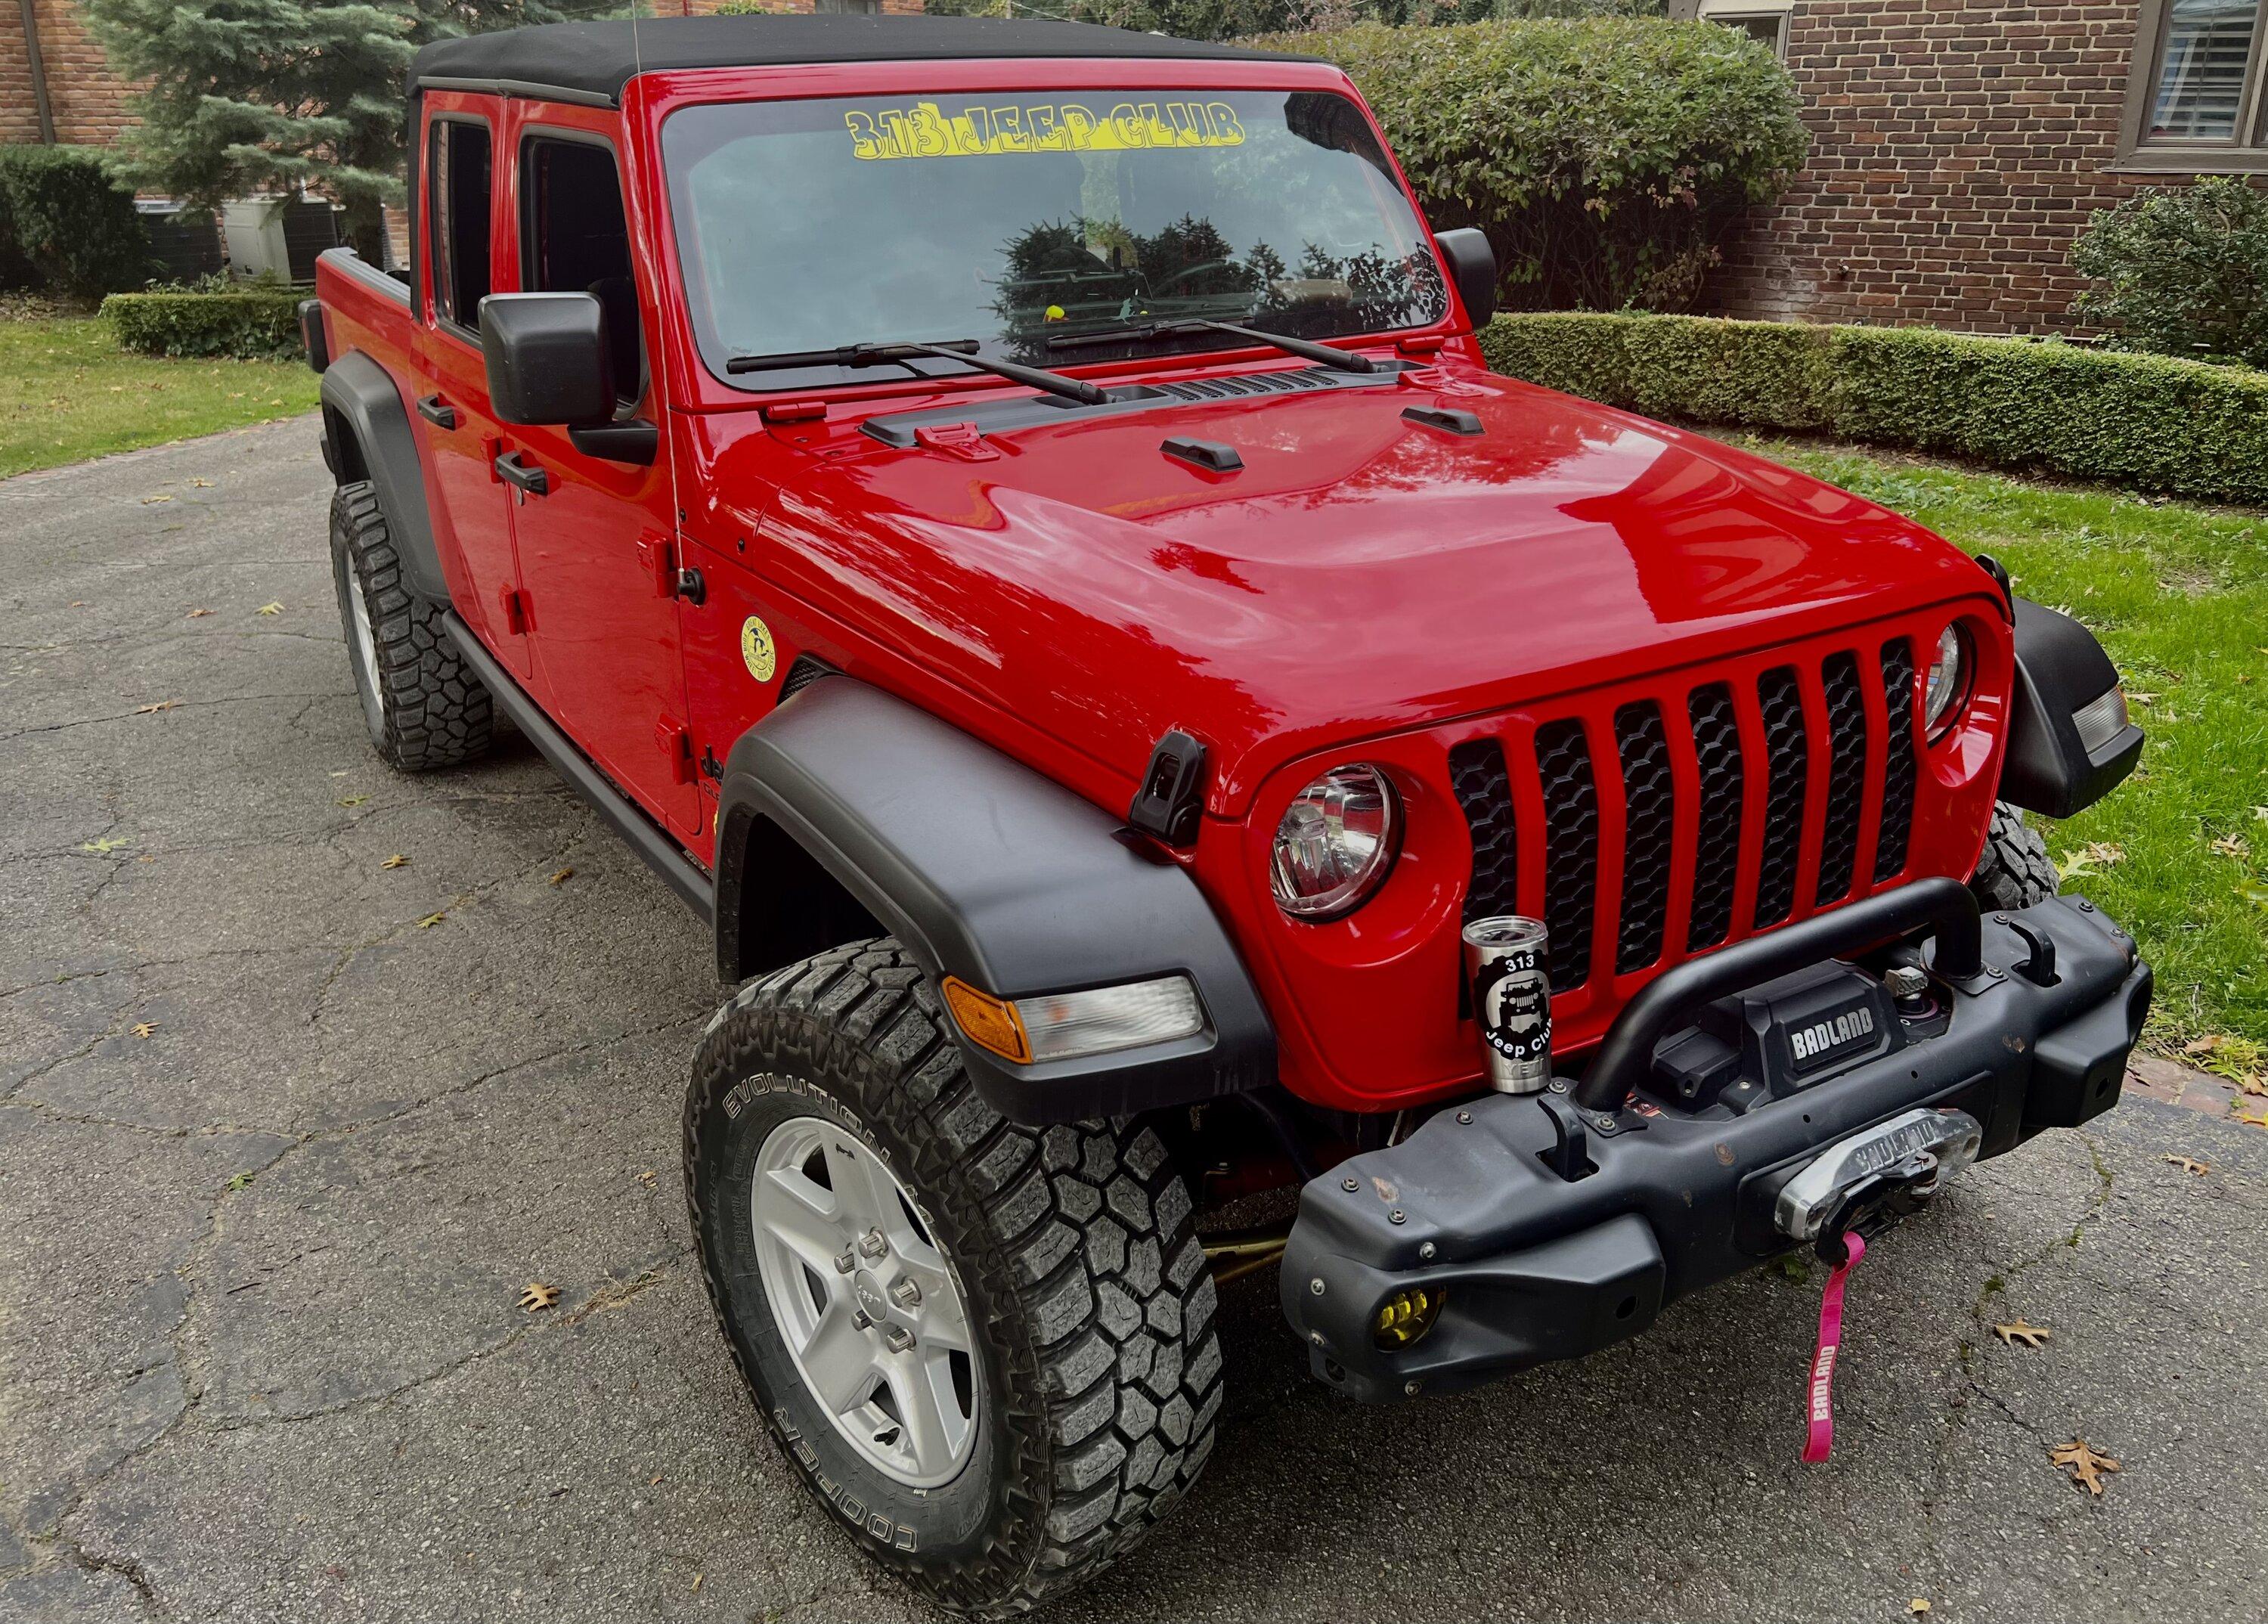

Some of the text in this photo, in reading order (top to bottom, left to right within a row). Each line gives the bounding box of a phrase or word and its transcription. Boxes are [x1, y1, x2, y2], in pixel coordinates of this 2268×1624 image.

[844, 102, 1246, 160] 313 JEEP CLUB
[1505, 953, 1535, 973] 313
[1486, 1017, 1552, 1058] Jeep Club
[1791, 1006, 1874, 1060] BADLAND
[1503, 1058, 1545, 1078] YETI
[722, 1072, 891, 1164] EVOLUTION
[1855, 1120, 1938, 1176] BADLAND
[1813, 1345, 1836, 1421] BADLAND
[773, 1406, 919, 1554] COOPER
